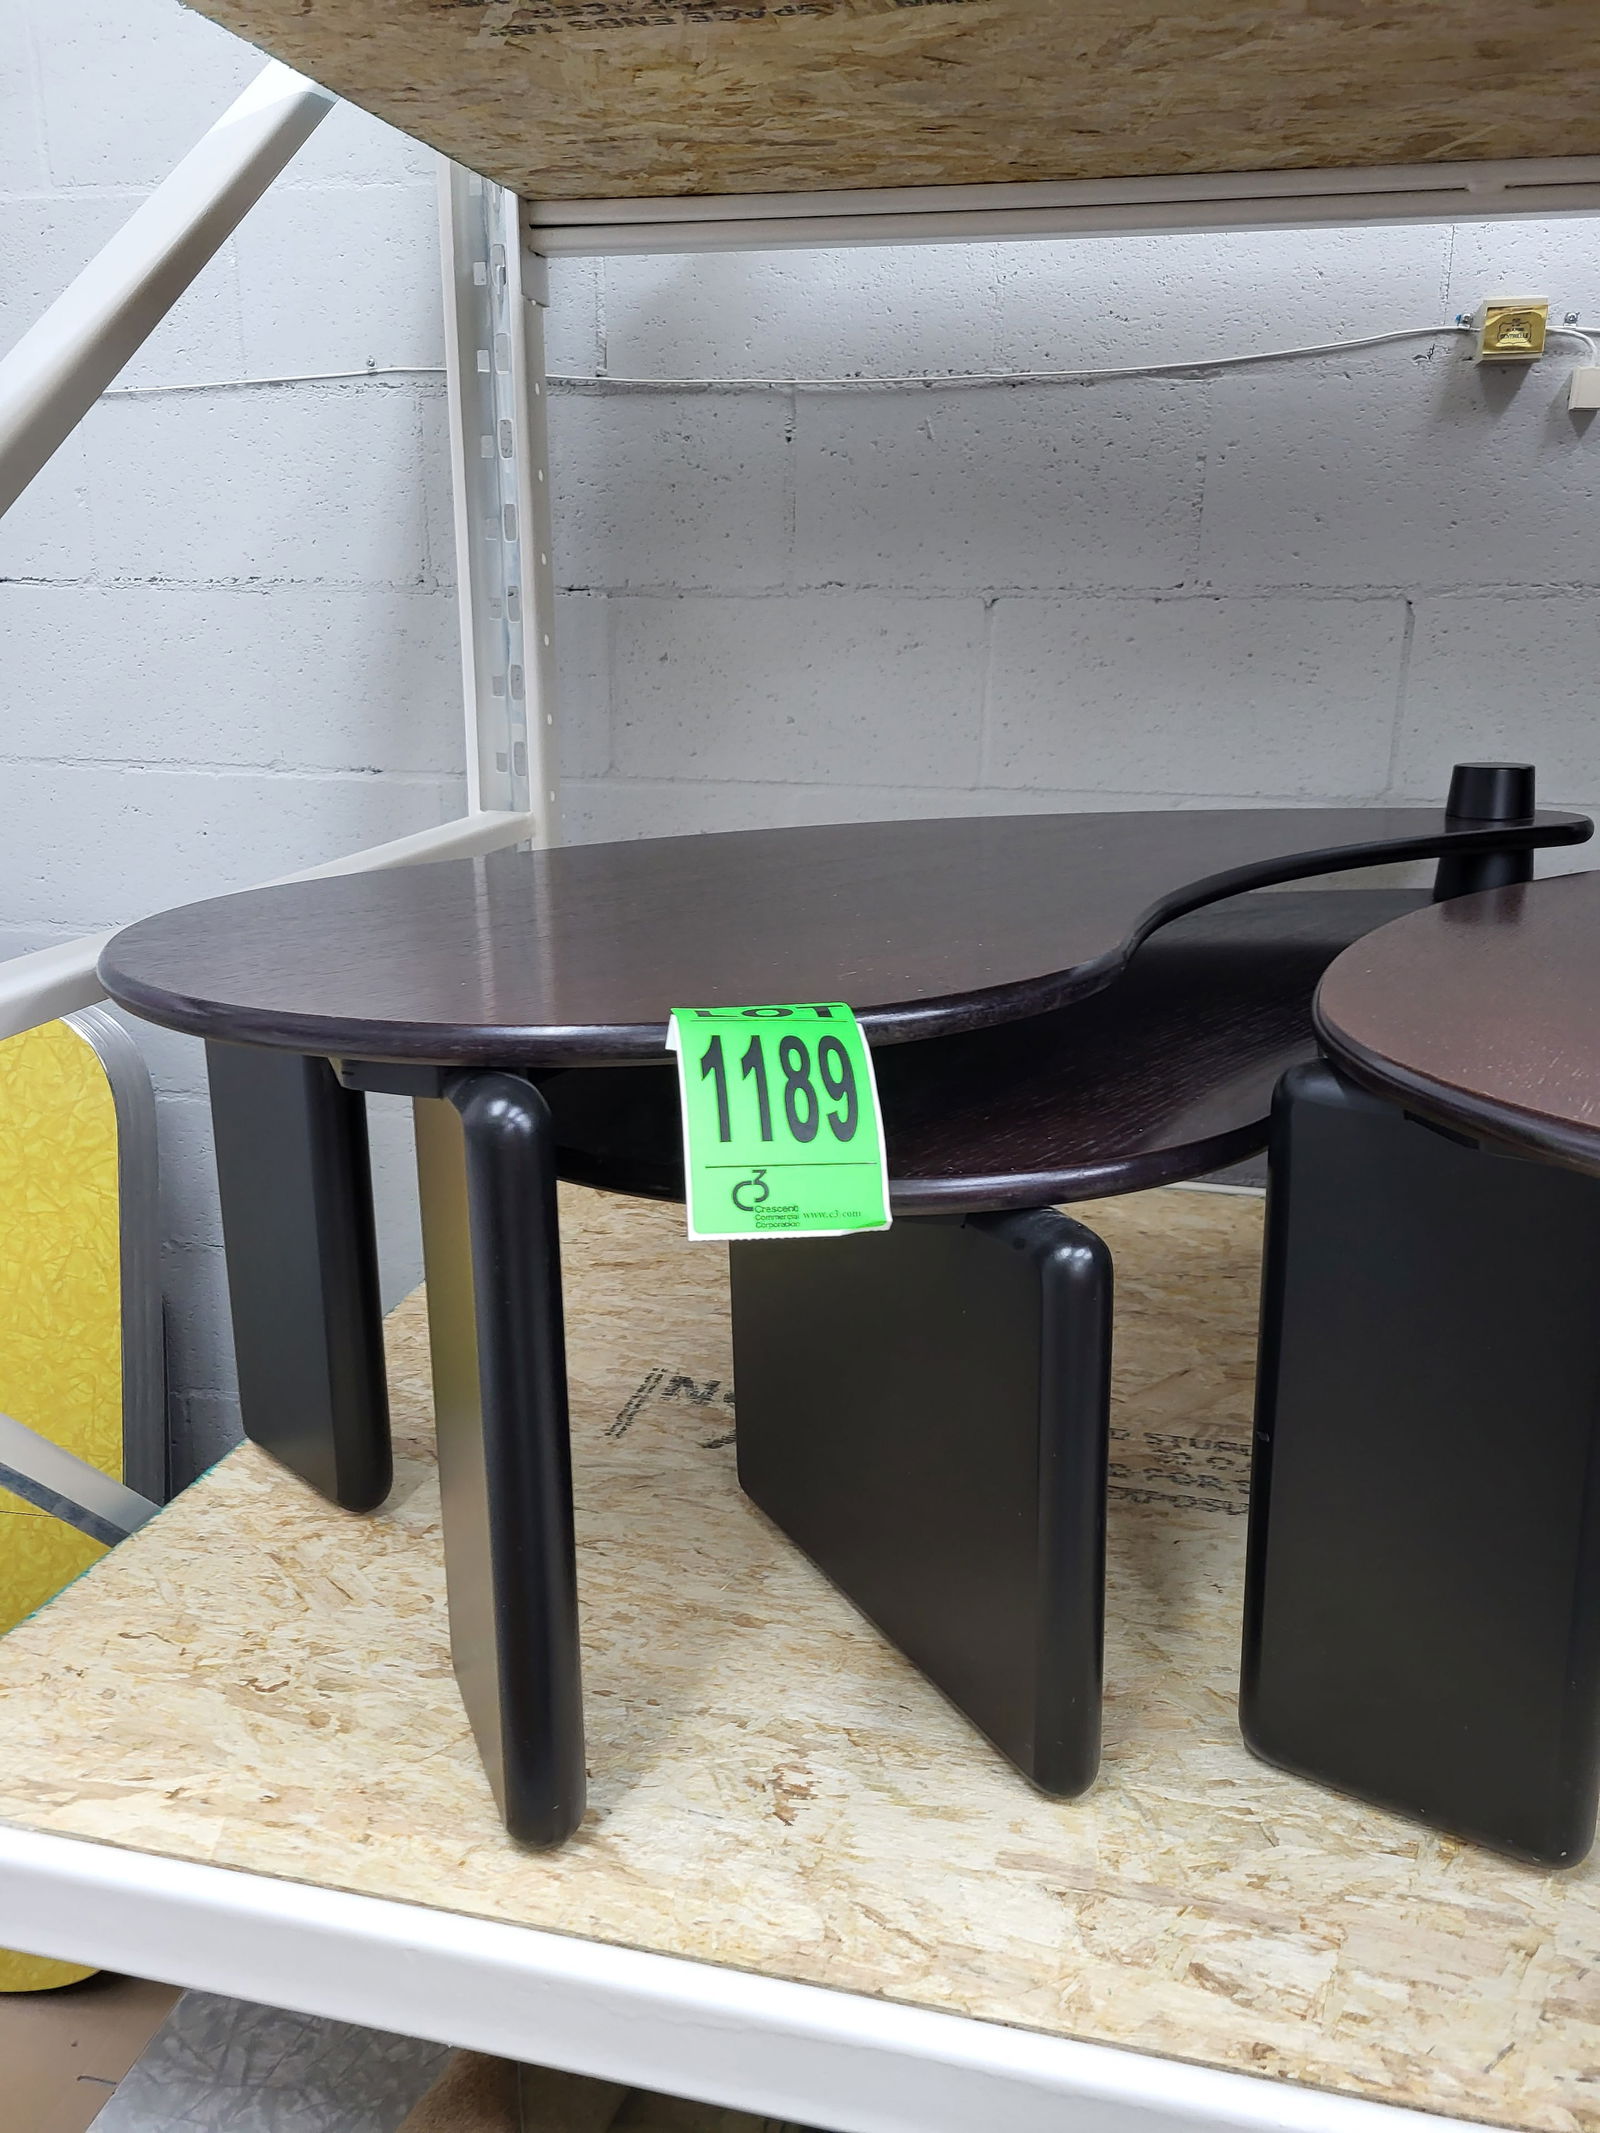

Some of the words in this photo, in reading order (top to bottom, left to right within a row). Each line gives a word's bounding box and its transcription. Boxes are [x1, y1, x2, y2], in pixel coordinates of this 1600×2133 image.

[567, 15, 677, 31] ENDS
[694, 1005, 844, 1018] LOT
[700, 1034, 858, 1144] 1189
[754, 1205, 799, 1214] Crescent
[754, 1213, 799, 1221] Commercial
[755, 1221, 801, 1229] Corporation
